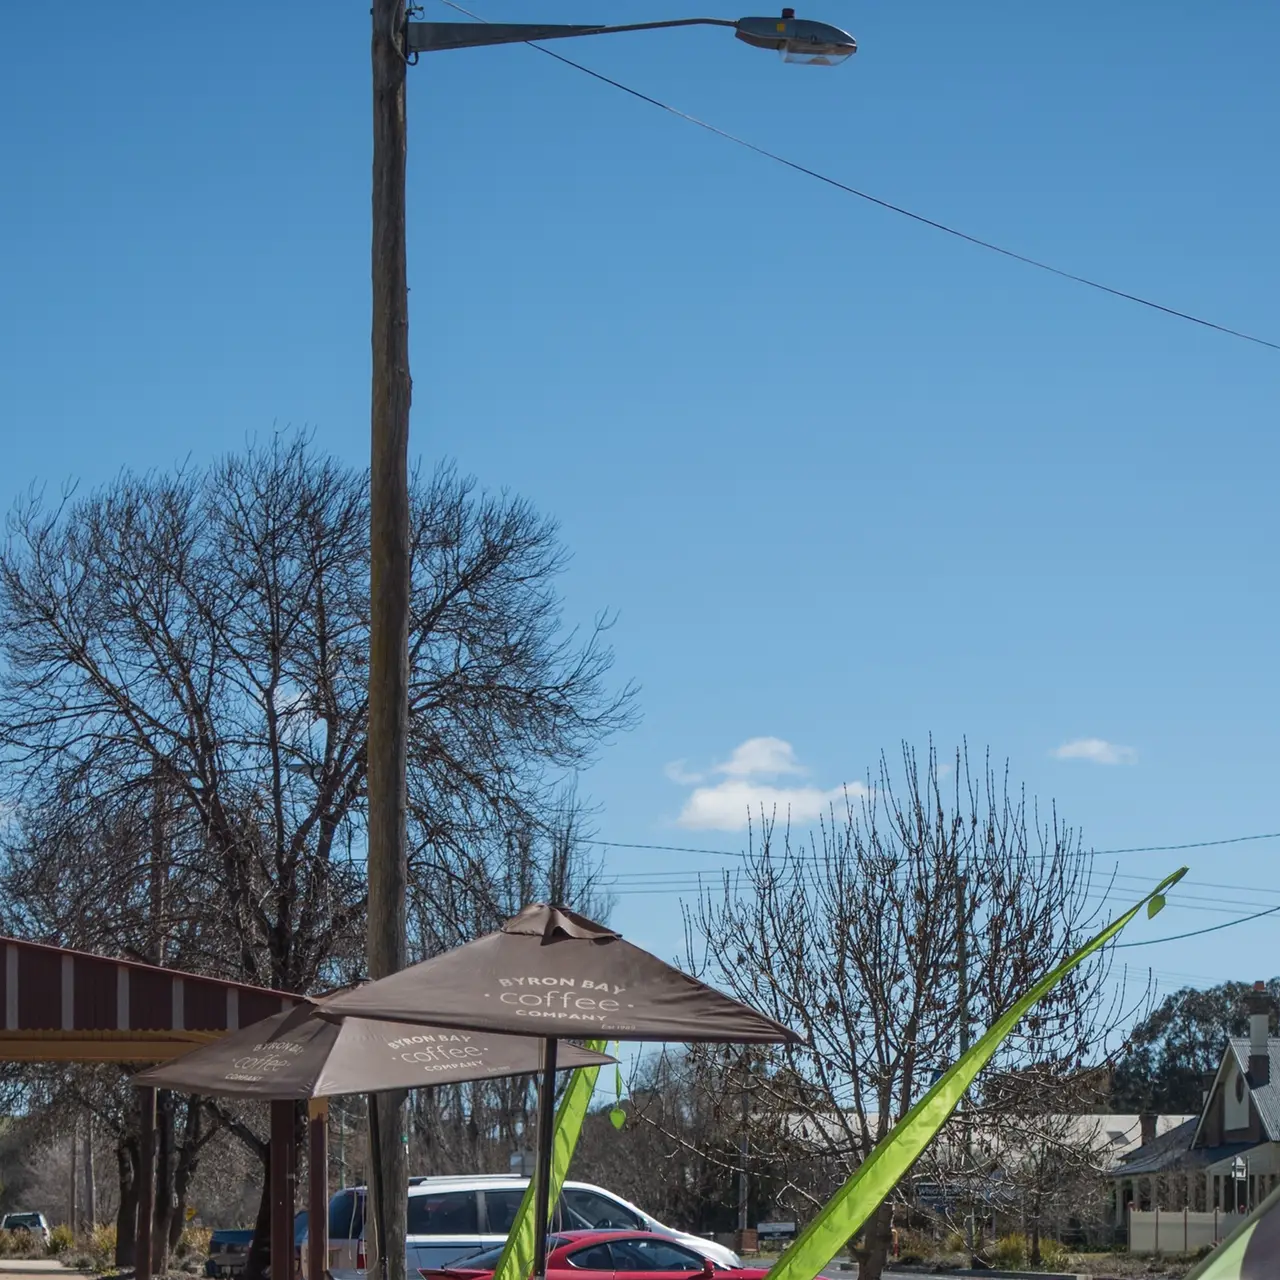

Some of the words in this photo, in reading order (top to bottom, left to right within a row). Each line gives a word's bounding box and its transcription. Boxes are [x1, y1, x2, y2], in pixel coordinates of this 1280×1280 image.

[498, 977, 575, 987] BYRON
[581, 980, 626, 995] BAY
[500, 990, 619, 1012] coffee
[516, 1009, 608, 1021] COMPANY
[387, 1034, 435, 1050] BYRON
[438, 1034, 472, 1043] BAY
[234, 1054, 288, 1071] coffee
[401, 1045, 482, 1063] coffee
[424, 1060, 484, 1072] COMPANY
